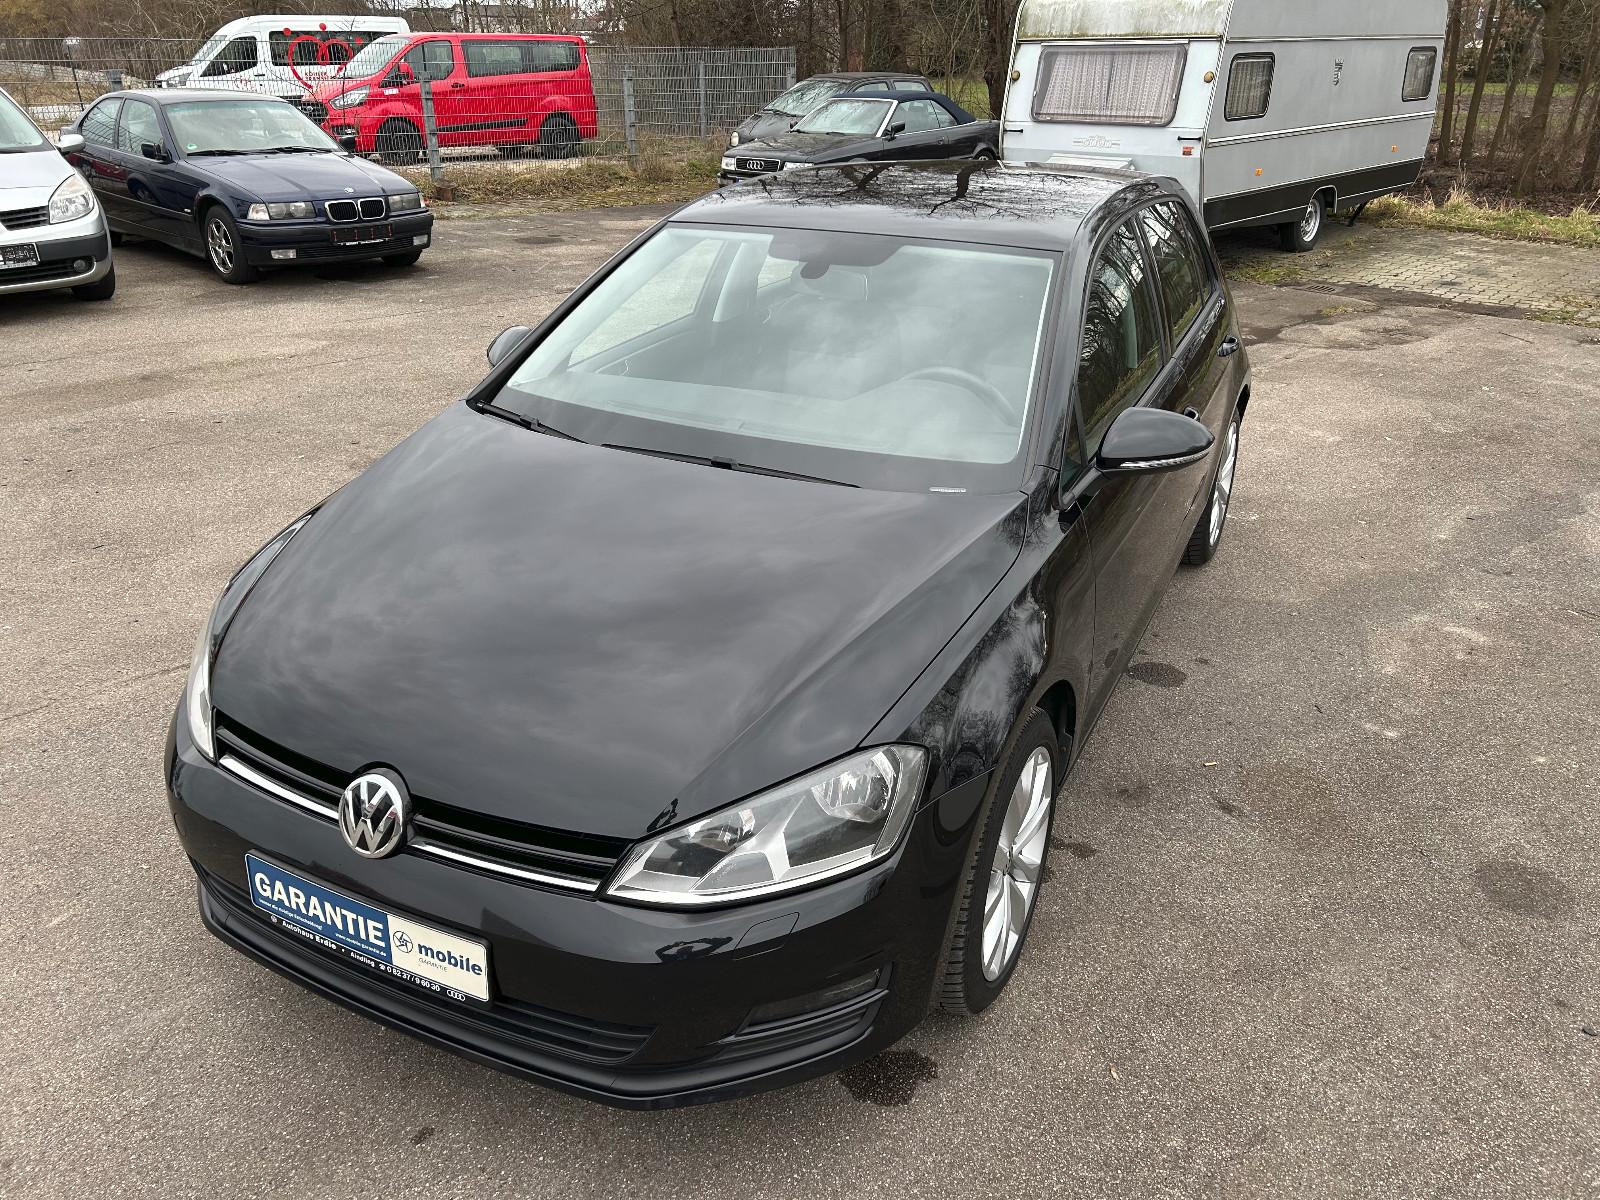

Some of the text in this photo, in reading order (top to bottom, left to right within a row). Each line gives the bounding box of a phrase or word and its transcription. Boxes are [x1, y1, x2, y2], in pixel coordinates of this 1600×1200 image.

[254, 872, 386, 948] GARANTIE
[282, 920, 314, 940] Autohaus
[417, 943, 483, 976] mobile
[418, 957, 448, 973] GARANTIE
